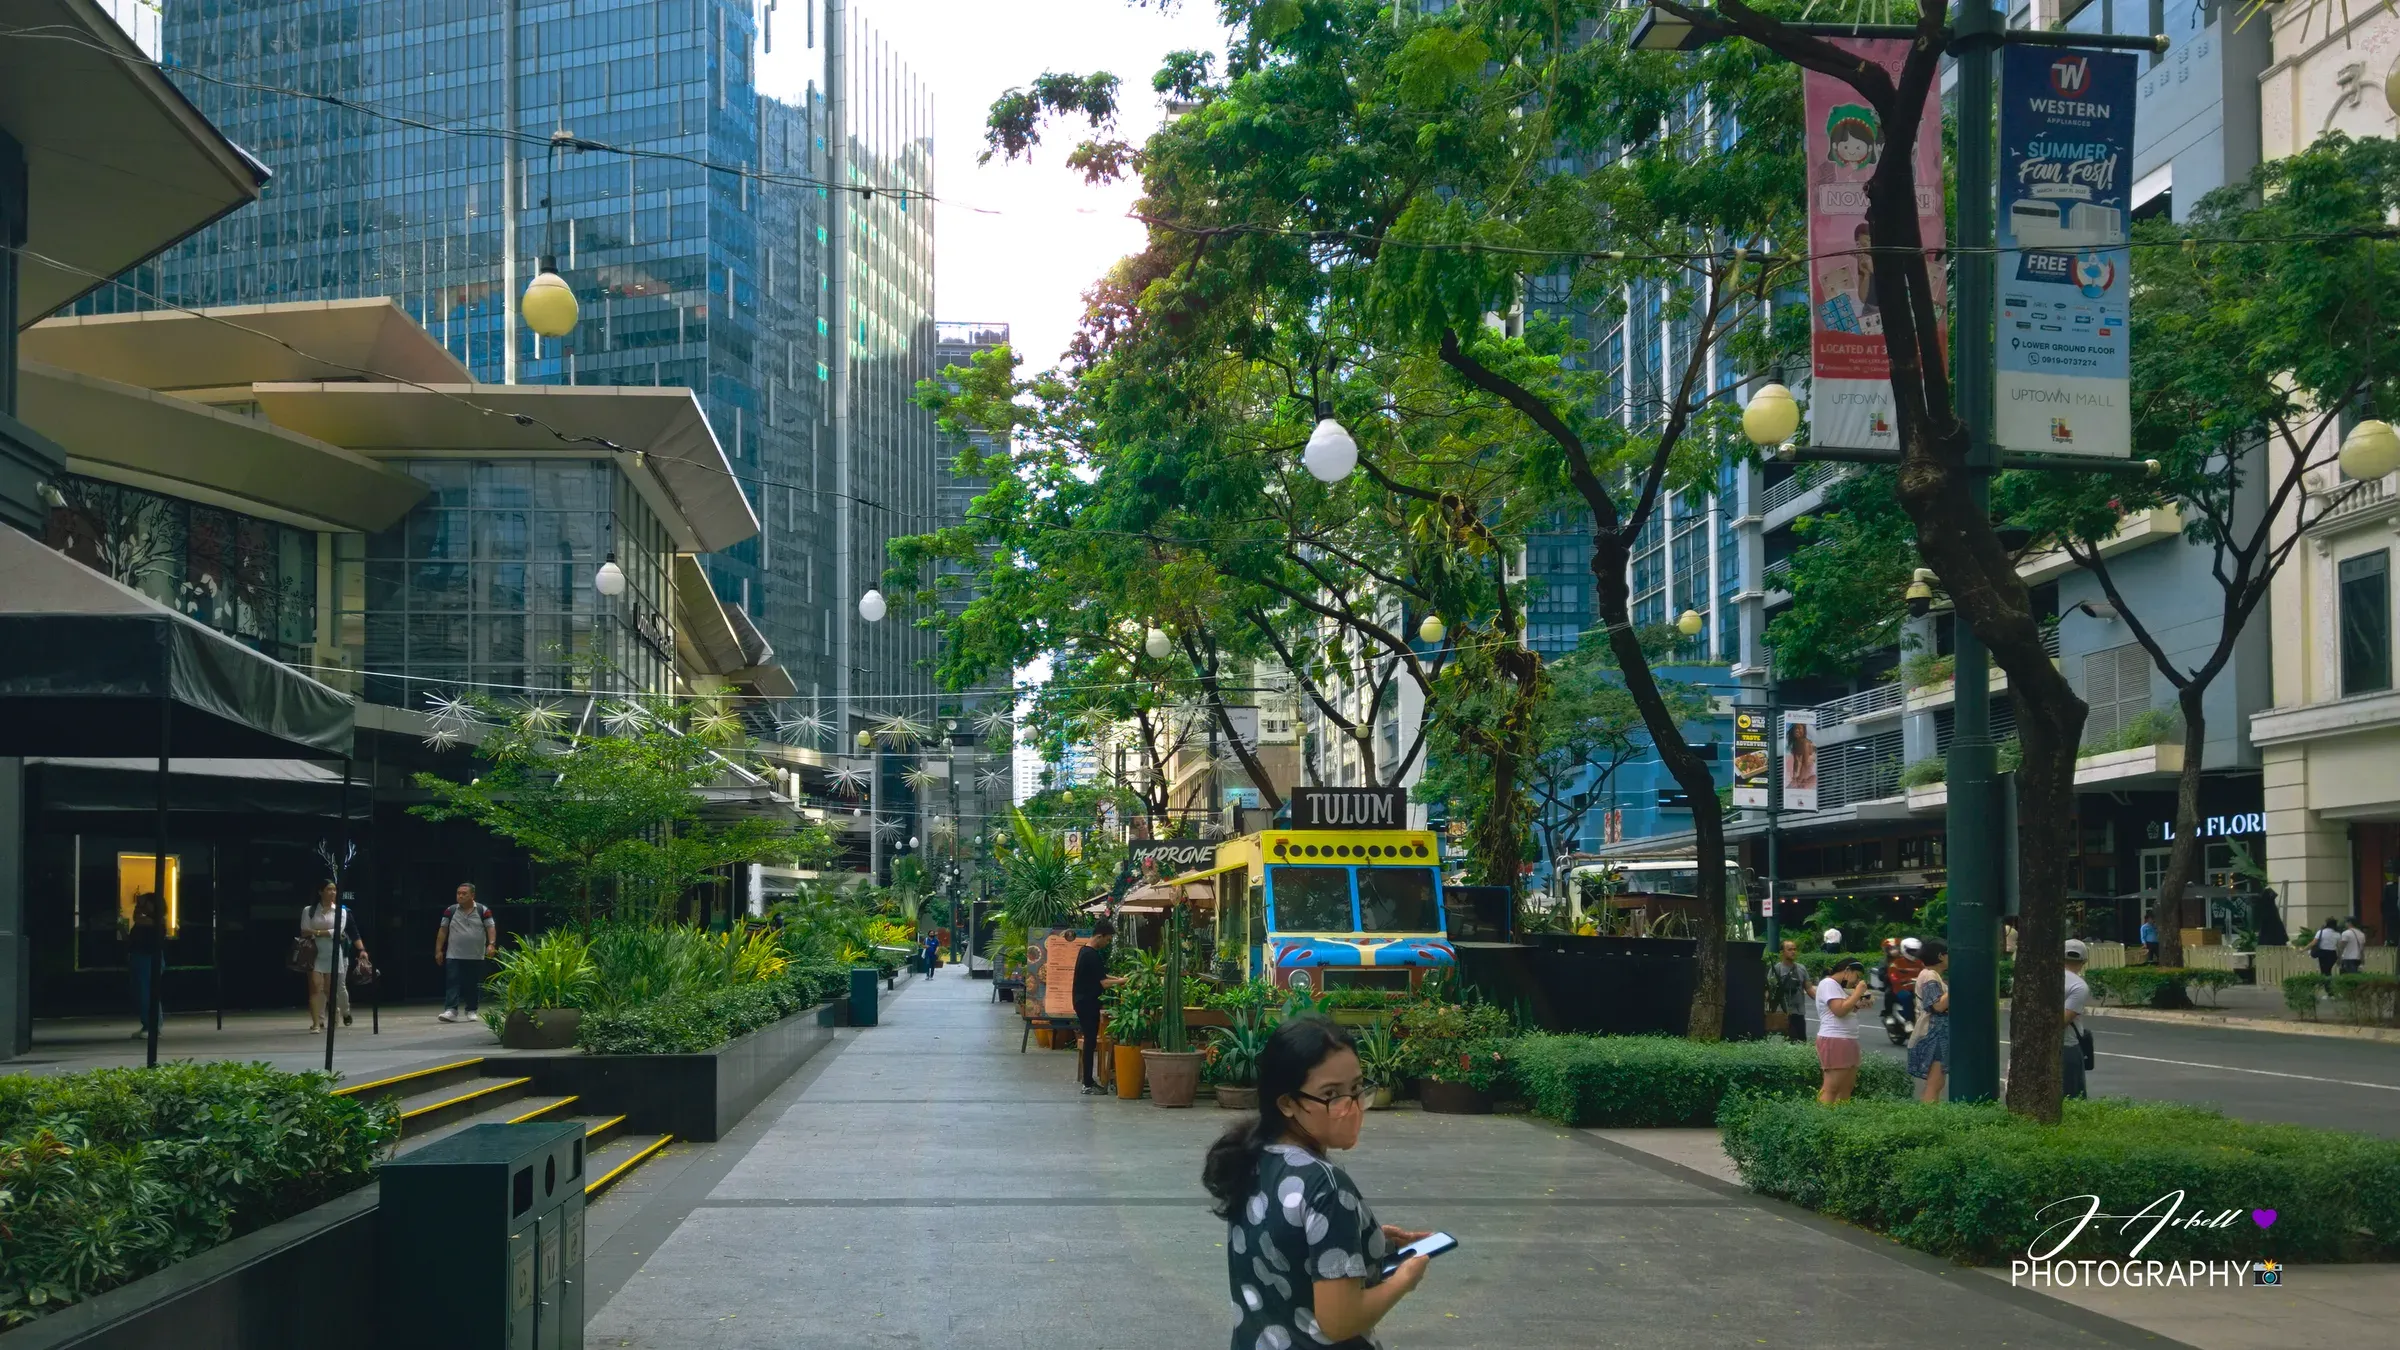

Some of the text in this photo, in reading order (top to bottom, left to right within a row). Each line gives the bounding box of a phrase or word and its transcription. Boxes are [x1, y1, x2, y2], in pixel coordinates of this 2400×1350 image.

[2029, 98, 2111, 119] WESTERN
[2046, 117, 2091, 127] APPLIANCES
[2027, 141, 2108, 160] SUMMER
[2018, 153, 2117, 191] Fan Fest!
[2027, 254, 2068, 272] FREE
[1820, 343, 1864, 355] LOCATED
[1866, 345, 1879, 355] AT
[2021, 341, 2115, 355] LOWER GROUND FLOOR
[2041, 356, 2097, 367] 0919-0737274
[1831, 391, 1888, 405] UPTOWN
[2011, 387, 2114, 407] UPTOWN MALL
[1306, 793, 1395, 825] TULUM
[1132, 845, 1217, 864] MADRONE
